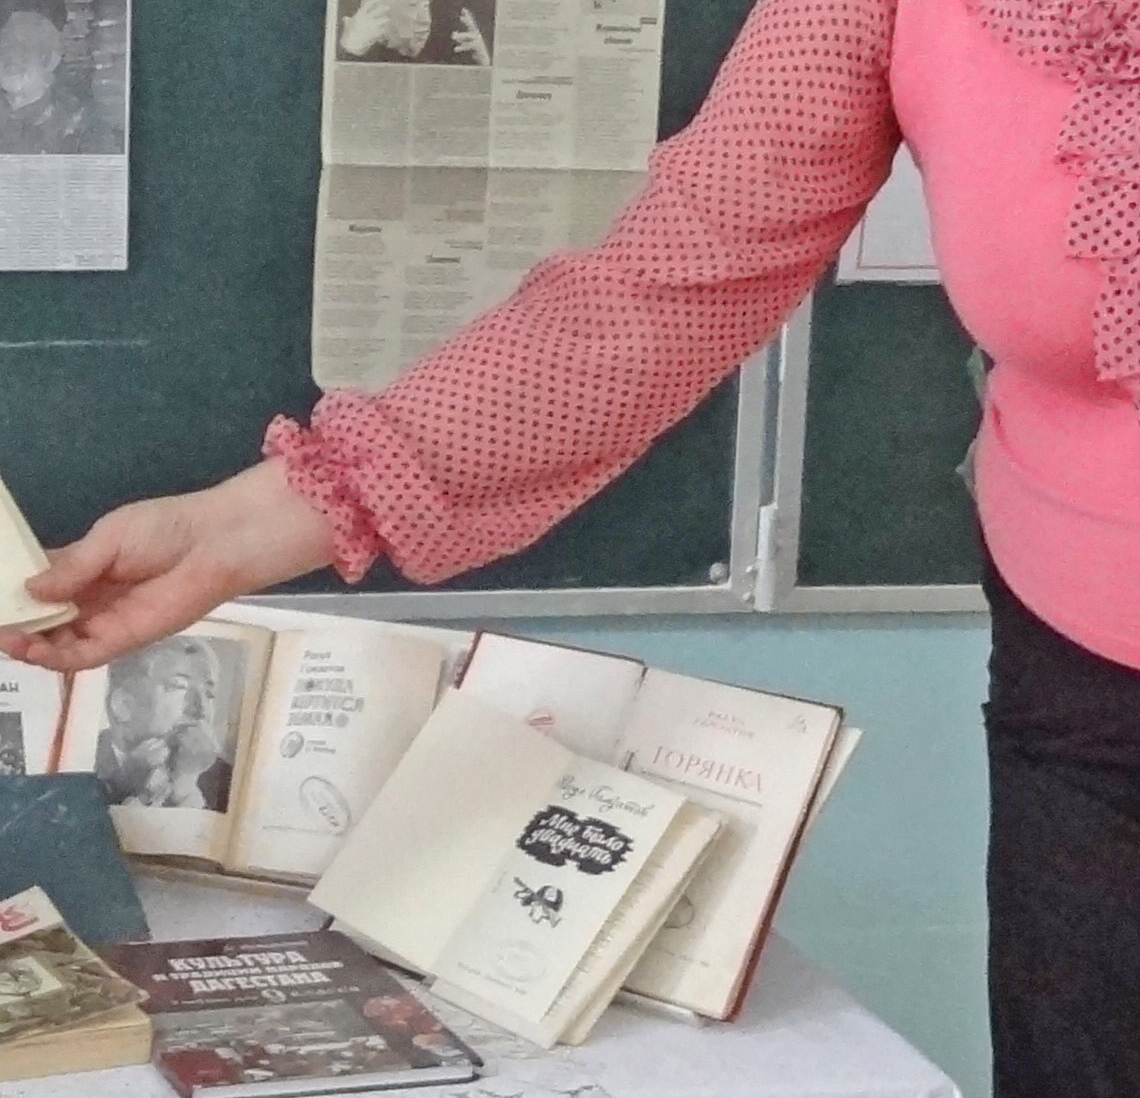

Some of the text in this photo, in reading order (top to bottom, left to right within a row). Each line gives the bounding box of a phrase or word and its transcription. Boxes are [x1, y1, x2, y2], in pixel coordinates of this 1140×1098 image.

[652, 745, 763, 793] ГОРЯНКА
[168, 951, 308, 971] КУЛЬТУРА
[188, 971, 332, 993] ДАГЕСТАНА
